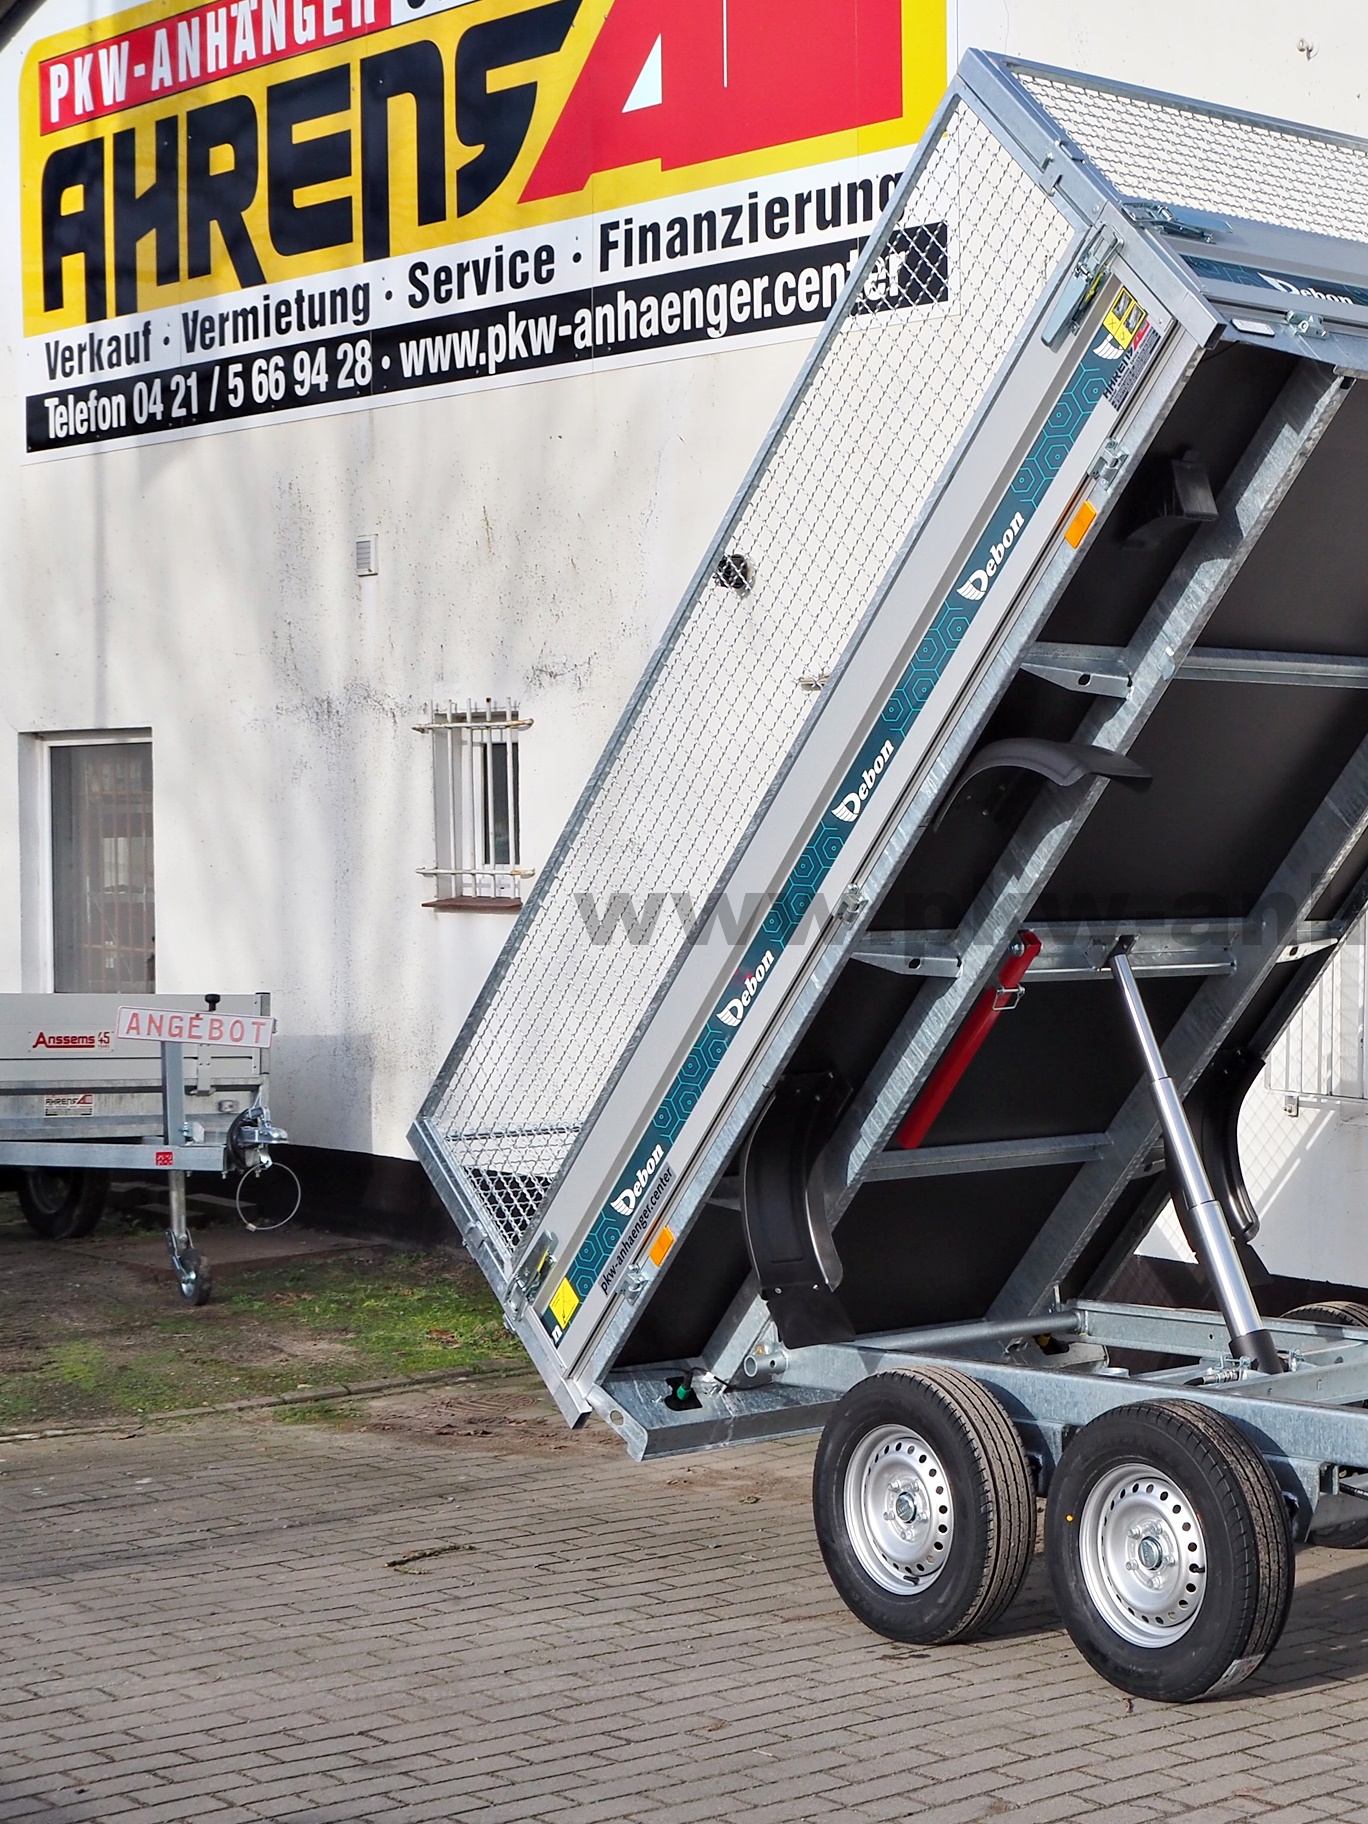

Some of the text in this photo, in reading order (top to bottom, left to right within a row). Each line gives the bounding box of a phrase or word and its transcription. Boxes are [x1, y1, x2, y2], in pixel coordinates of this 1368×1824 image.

[45, 320, 152, 380] Verkauf
[182, 281, 371, 353] Vermietung
[408, 243, 555, 309] Service
[1258, 272, 1353, 304] Debon
[44, 389, 126, 439] Telefon
[133, 378, 164, 425] 04
[171, 371, 199, 417] 21
[228, 363, 244, 407] 5
[251, 354, 285, 403] 66
[293, 346, 328, 396] 94
[337, 339, 372, 389] 28
[956, 511, 1025, 601] Debon
[830, 739, 895, 822] Debon
[125, 1011, 266, 1043] ANGEBOT
[716, 950, 775, 1027] Debon
[32, 1031, 95, 1048] Anssems
[610, 1145, 664, 1216] Debon
[600, 1167, 673, 1296] pkw-anhaenger.center
